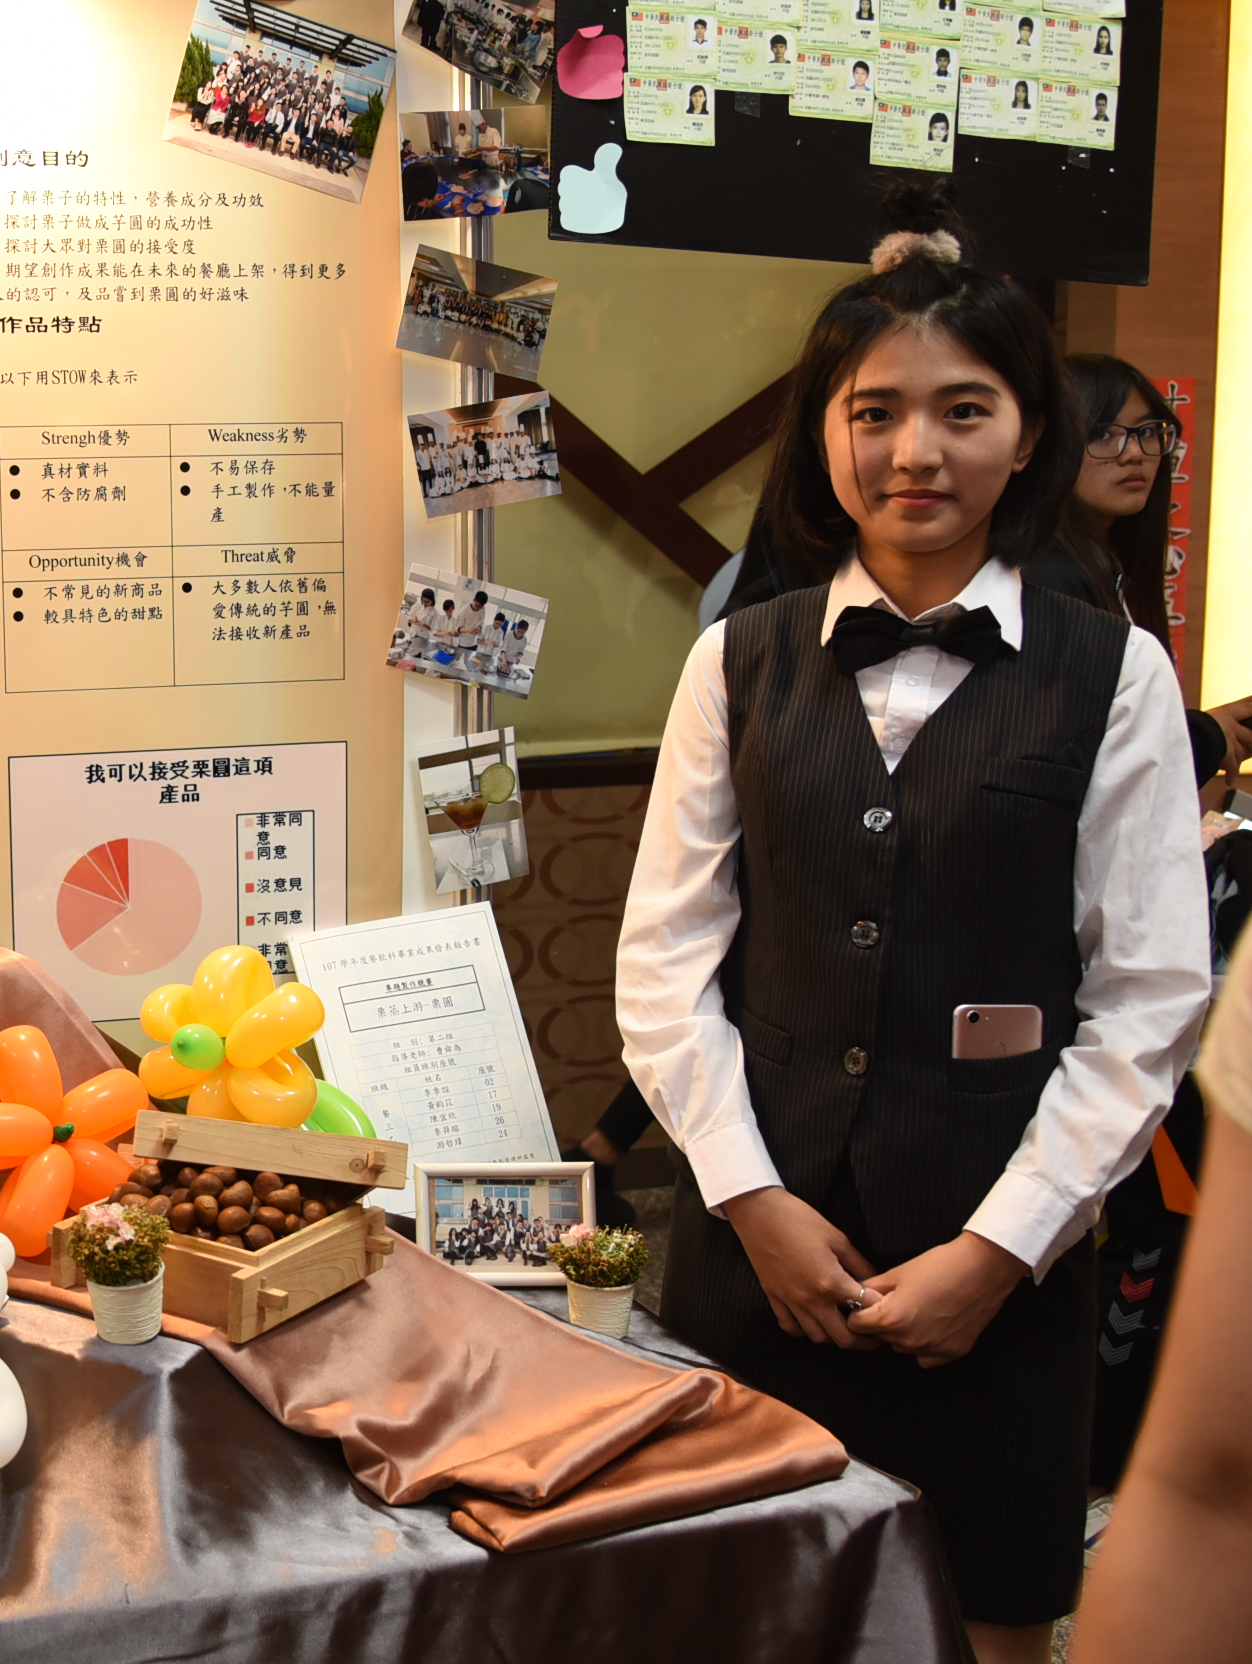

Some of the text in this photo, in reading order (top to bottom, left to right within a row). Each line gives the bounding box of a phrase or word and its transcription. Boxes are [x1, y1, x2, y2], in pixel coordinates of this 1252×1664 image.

[0, 369, 138, 386] 以下用STOW來表示
[41, 429, 130, 448] Strengh優勢
[207, 428, 308, 444] Weakness劣勢
[41, 462, 109, 479] 真材實料
[210, 458, 276, 476] 不易保存
[40, 486, 126, 502] 不含防腐劑
[210, 507, 225, 523] 產
[29, 552, 148, 571] Opportunity機會
[221, 547, 297, 565] Threat威脅
[43, 583, 163, 601] 不常見的新商品
[212, 578, 327, 596] 大多數人依舊偏
[43, 606, 163, 624] 較具特色的甜點
[212, 624, 311, 641] 法接收新產品
[84, 757, 274, 784] 我可以接受栗圓這項
[159, 784, 200, 804] 產品
[256, 813, 303, 828] 非常同
[257, 831, 271, 846] 意
[257, 845, 288, 861] 同意
[256, 878, 303, 894] 沒意見
[257, 910, 304, 926] 不同意
[485, 1078, 495, 1086] 02
[488, 1090, 497, 1099] 17
[492, 1104, 501, 1112] 19
[495, 1117, 505, 1125] 26
[498, 1129, 508, 1138] 24
